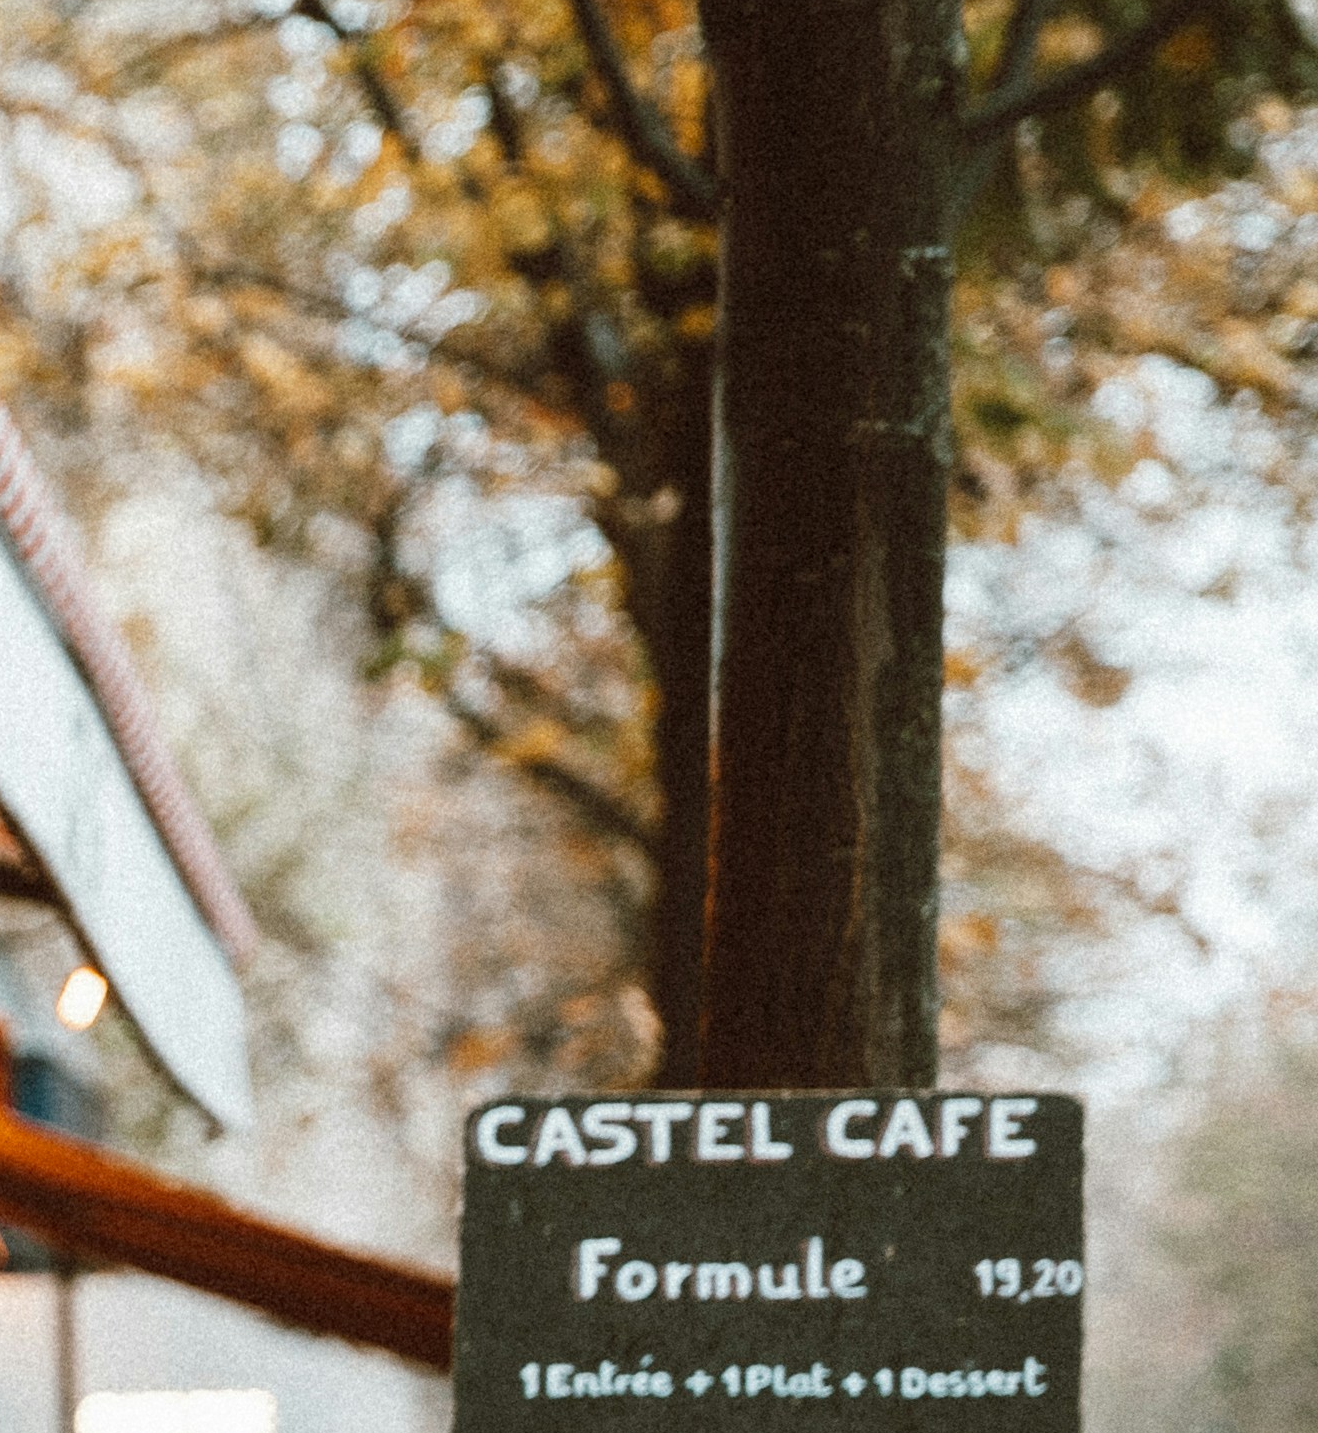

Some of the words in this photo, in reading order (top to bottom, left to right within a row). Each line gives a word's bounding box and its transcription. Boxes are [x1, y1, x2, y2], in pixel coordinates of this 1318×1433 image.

[474, 1100, 795, 1166] CASTEL
[825, 1097, 1038, 1159] CAFE
[577, 1236, 867, 1302] Formule
[974, 1257, 1085, 1303] 19,20
